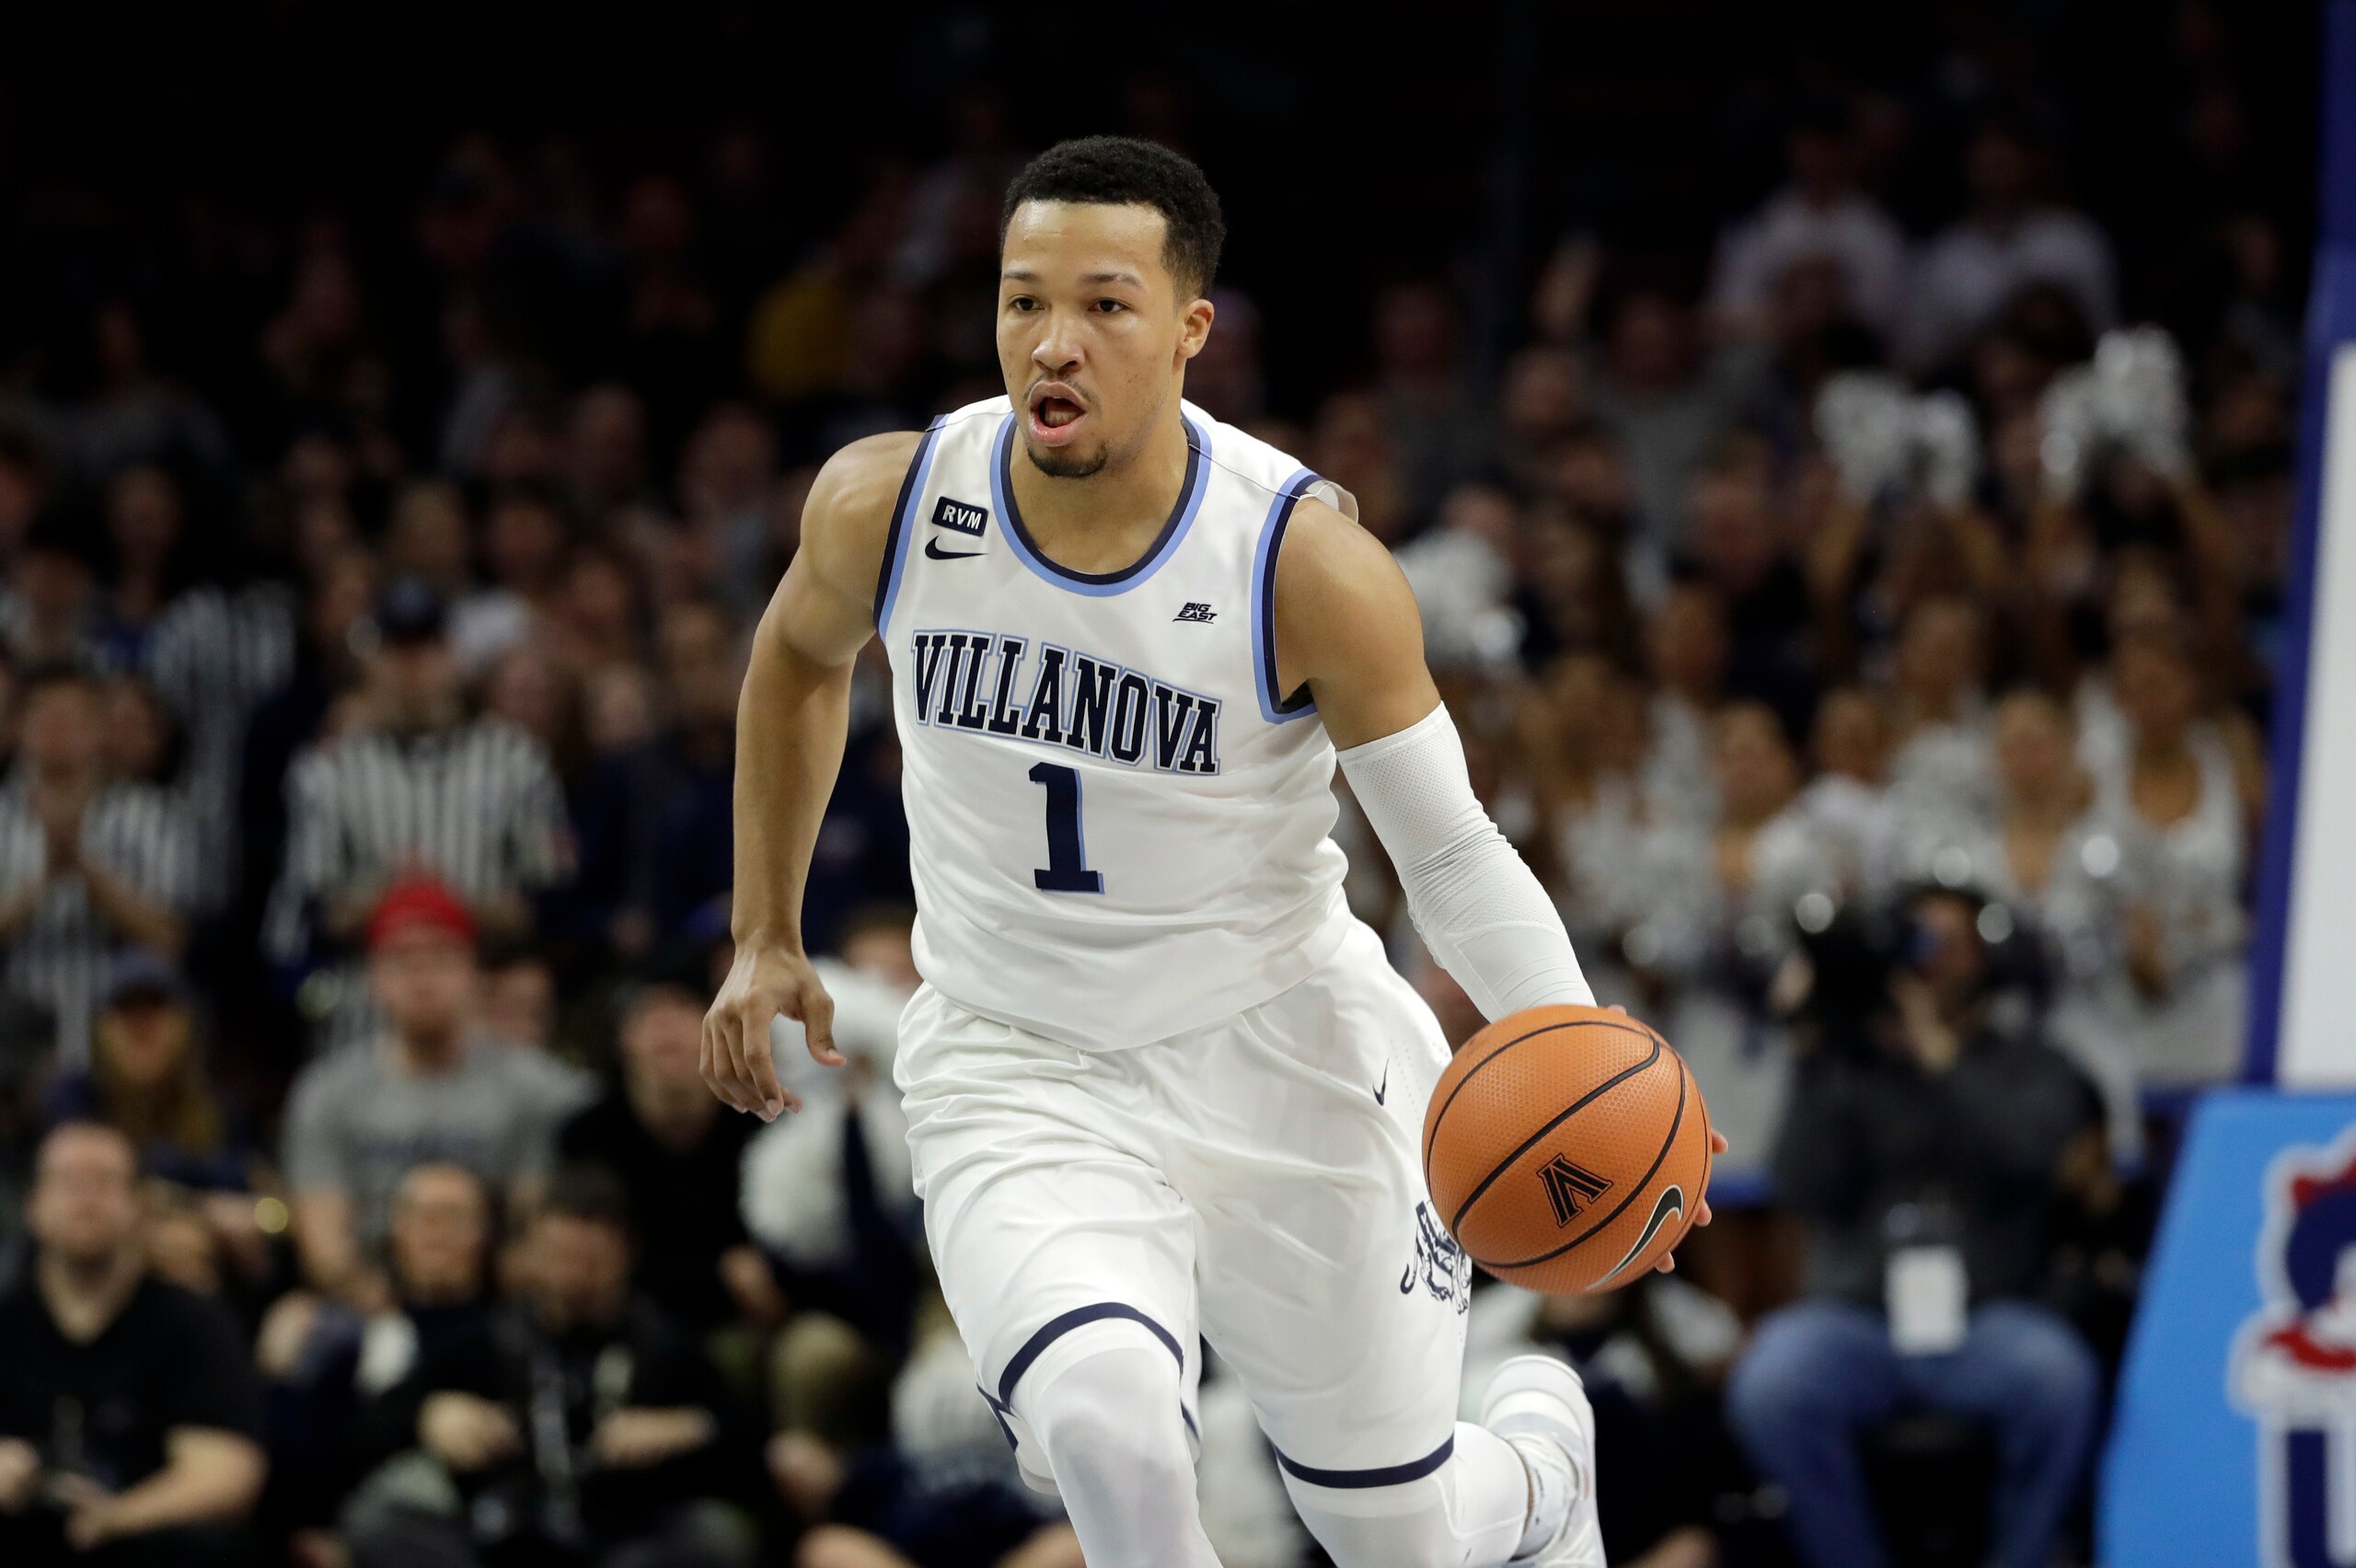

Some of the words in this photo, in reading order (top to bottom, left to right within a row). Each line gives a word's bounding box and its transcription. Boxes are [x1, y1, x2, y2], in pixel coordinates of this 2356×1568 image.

[942, 504, 982, 530] RVM
[1177, 610, 1218, 621] EAST
[1183, 602, 1211, 612] BIG
[912, 629, 1222, 776] VILLANOVA
[1029, 762, 1103, 894] 1
